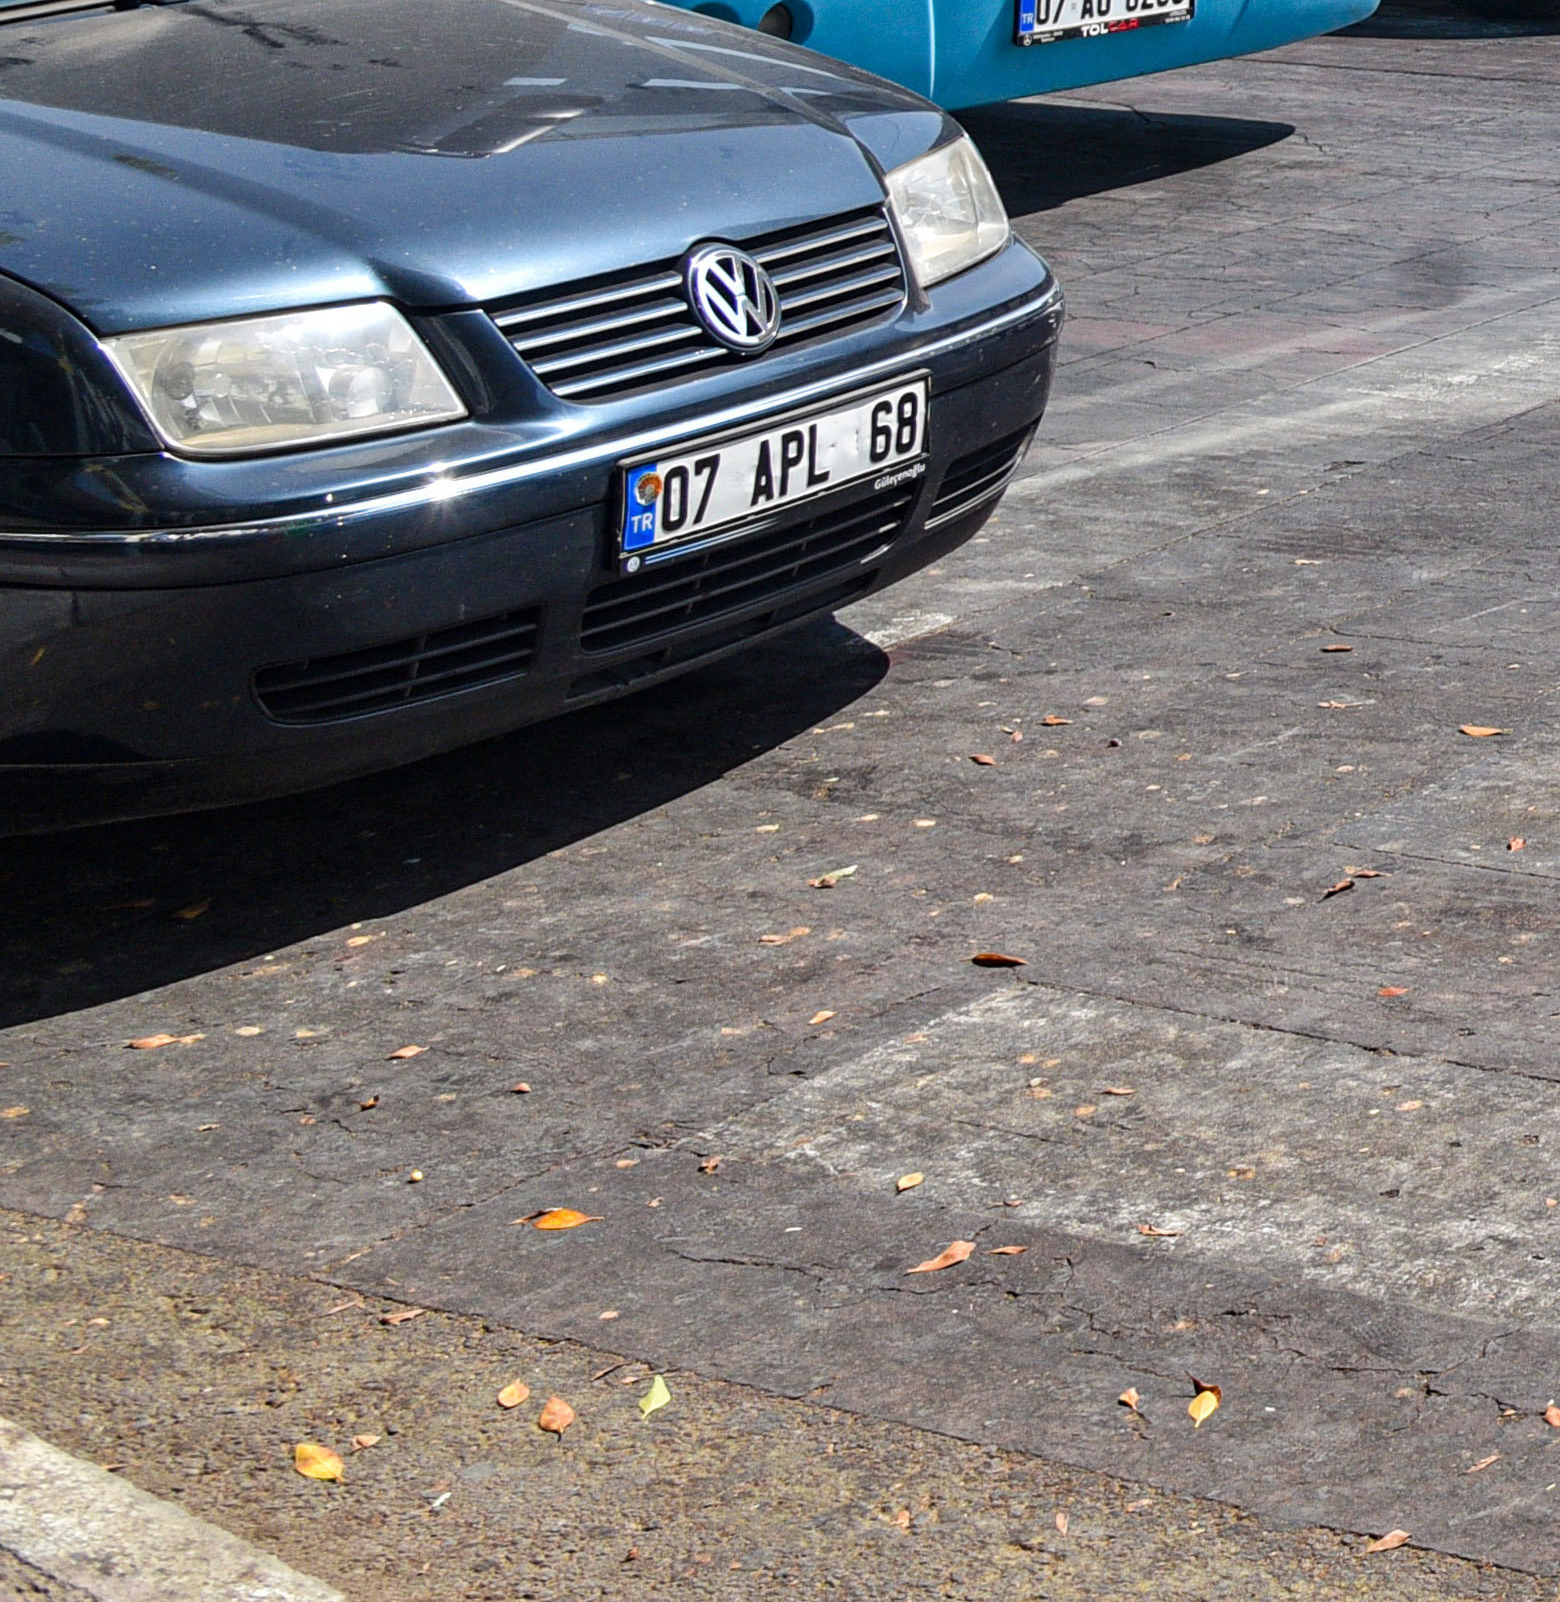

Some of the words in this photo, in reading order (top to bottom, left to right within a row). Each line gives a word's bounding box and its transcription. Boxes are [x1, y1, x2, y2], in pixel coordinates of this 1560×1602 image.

[1021, 12, 1034, 24] TR
[1080, 18, 1140, 38] TOLCAR
[661, 452, 720, 533] 07
[750, 423, 831, 507] APL
[868, 391, 919, 464] 68
[630, 511, 653, 535] TR
